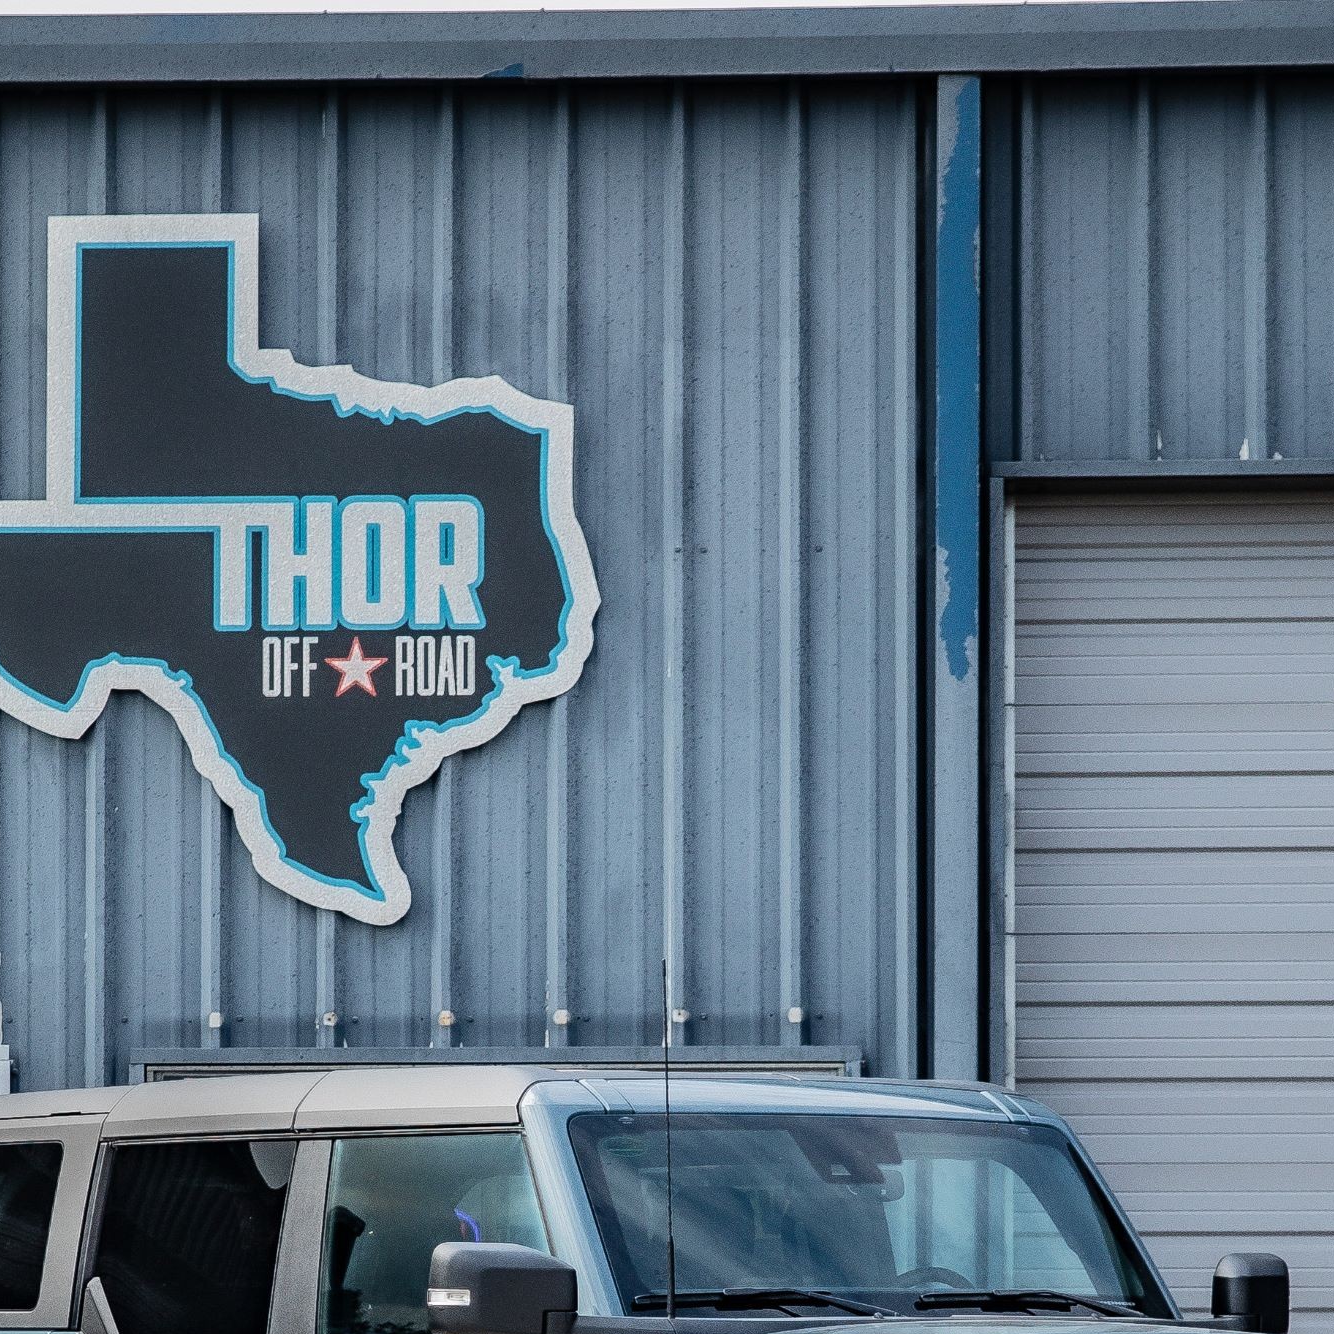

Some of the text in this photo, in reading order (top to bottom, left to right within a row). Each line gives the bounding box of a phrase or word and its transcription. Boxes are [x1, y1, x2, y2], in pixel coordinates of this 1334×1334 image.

[214, 496, 484, 630] THOR
[262, 635, 476, 698] OFF ROAD
